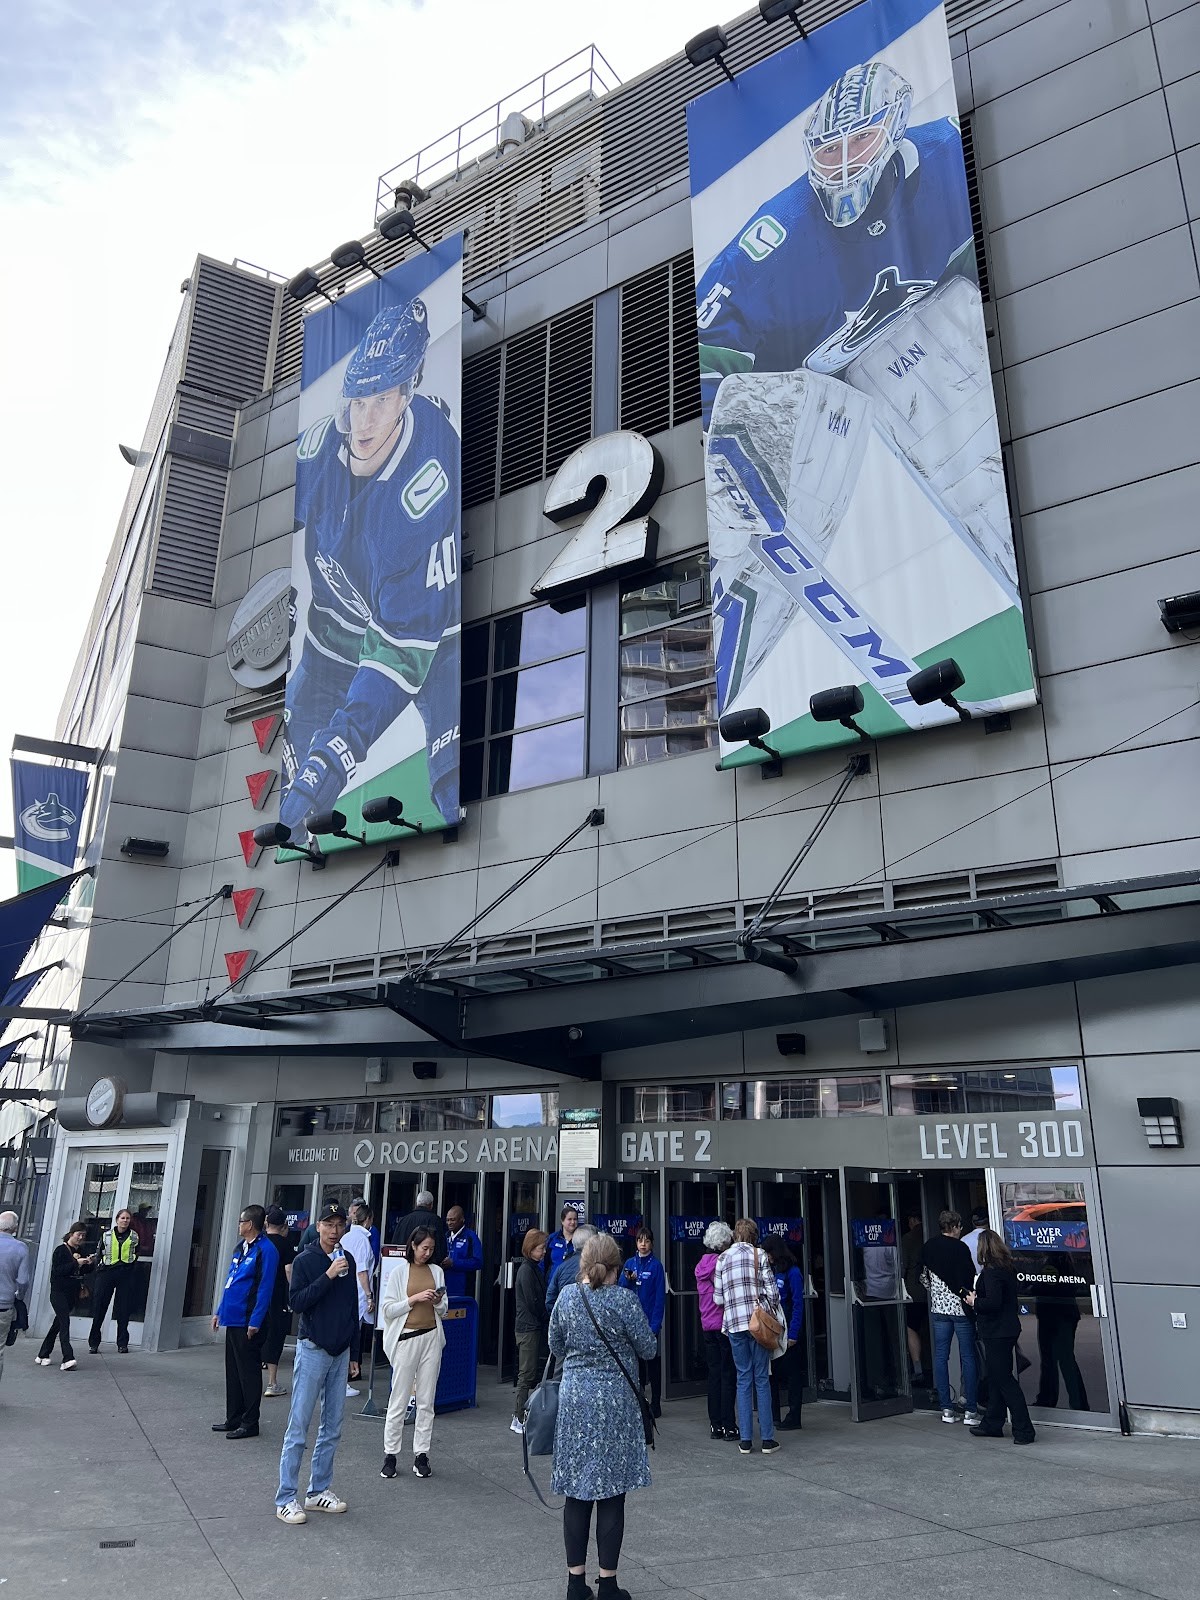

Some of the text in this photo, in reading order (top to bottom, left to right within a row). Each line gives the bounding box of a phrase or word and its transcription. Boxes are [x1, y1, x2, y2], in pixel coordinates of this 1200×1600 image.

[366, 339, 387, 359] 40
[886, 341, 928, 379] VAN
[827, 409, 852, 439] VAN
[530, 430, 660, 596] 2
[425, 531, 458, 592] 40
[760, 532, 913, 679] CCM
[230, 606, 277, 658] CENTRE
[288, 1148, 326, 1162] WELCOME
[328, 1147, 340, 1161] TO
[379, 1139, 469, 1165] ROGERS
[476, 1135, 558, 1163] ARENA
[621, 1130, 684, 1162] GATE
[694, 1129, 711, 1162] 2
[919, 1120, 1085, 1160] LEVEL 300
[608, 1219, 628, 1228] LAVER
[684, 1221, 705, 1230] LAVER
[768, 1222, 789, 1232] LAVER
[864, 1224, 882, 1234] LAVER
[1030, 1227, 1062, 1237] LAVER
[868, 1233, 879, 1241] CUP
[1036, 1236, 1056, 1244] CUP
[1025, 1273, 1087, 1284] ROGERS ARENA
